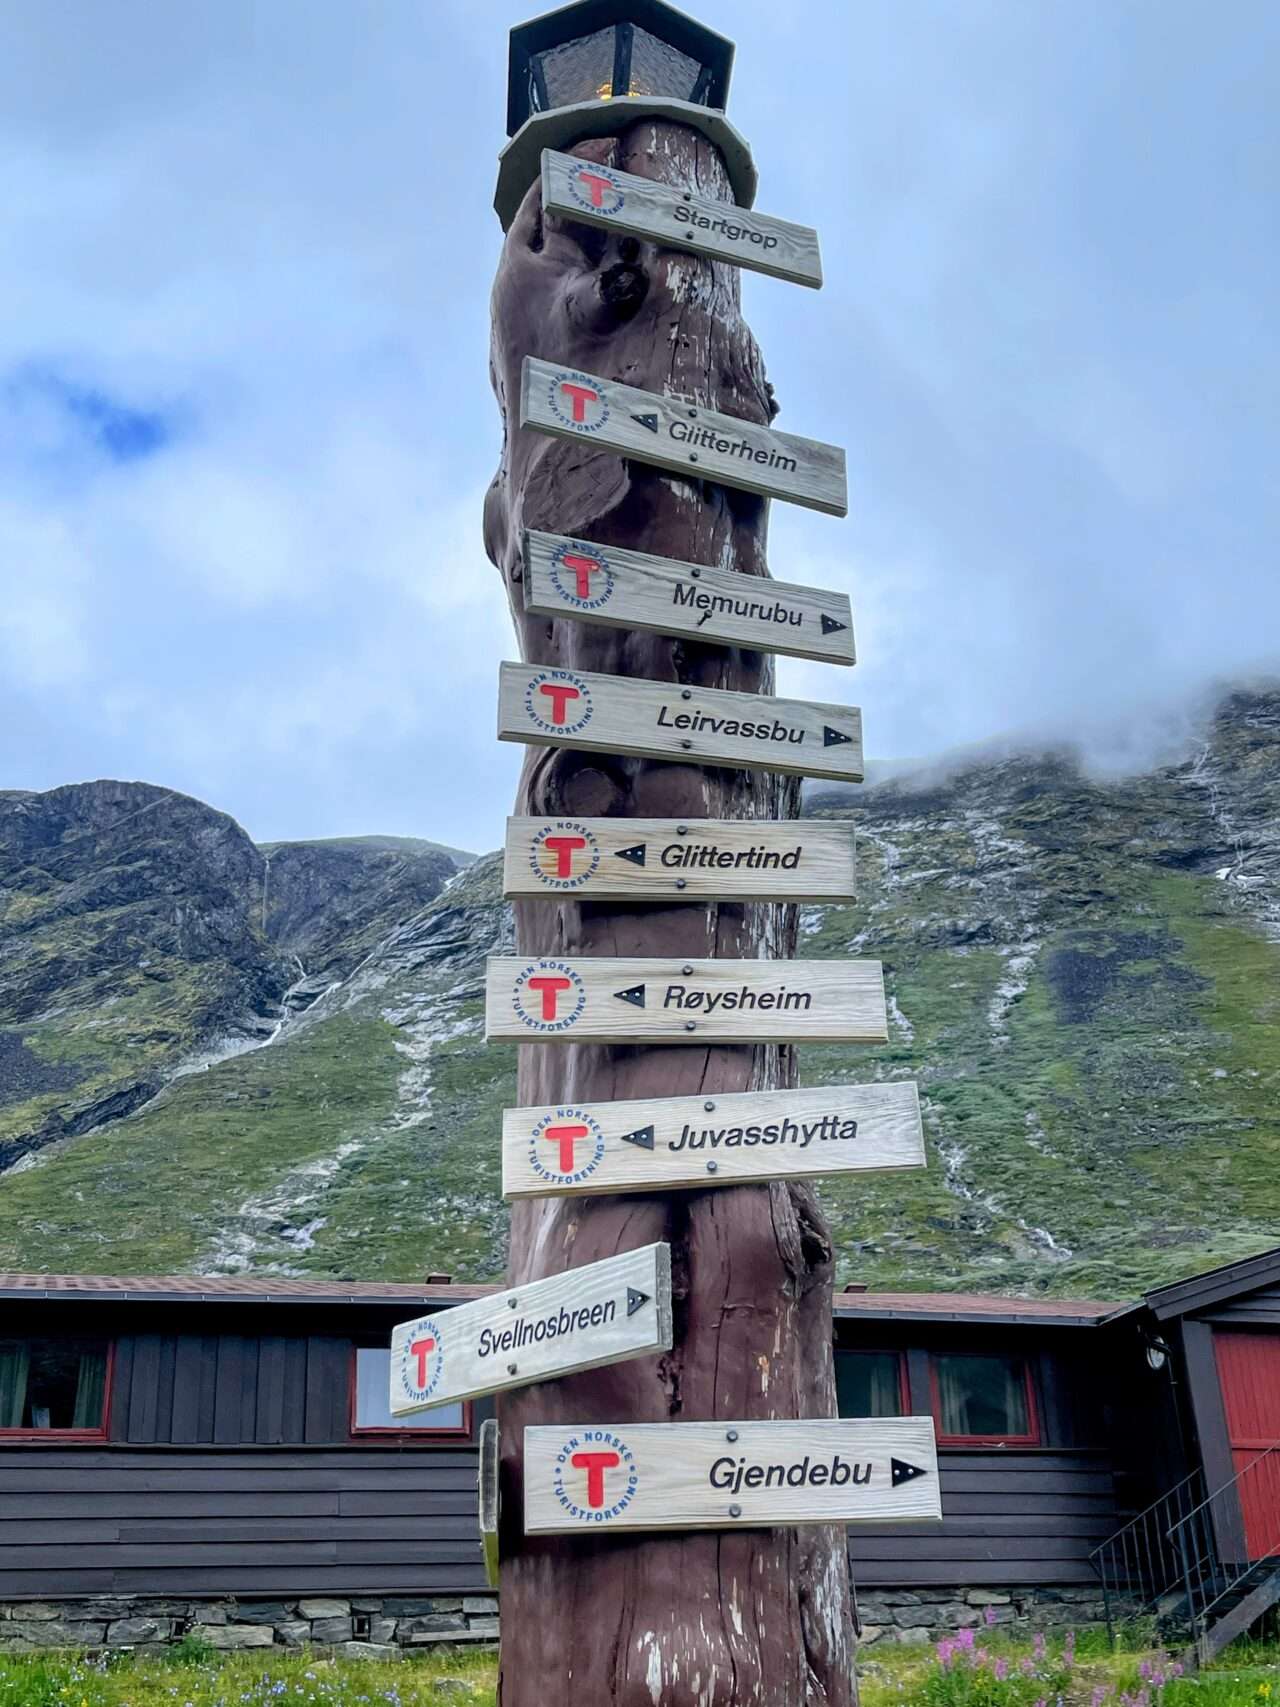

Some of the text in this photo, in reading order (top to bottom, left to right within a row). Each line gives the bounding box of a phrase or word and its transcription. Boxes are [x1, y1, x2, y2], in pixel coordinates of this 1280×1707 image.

[579, 171, 613, 208] T
[673, 205, 778, 250] Startgrop
[561, 383, 597, 422] T
[669, 421, 797, 473] Glitterheim
[562, 555, 600, 599] T
[673, 583, 803, 627] Memurubu
[528, 671, 590, 696] DEN NORSKE
[525, 700, 594, 735] TURISTFORENING
[540, 684, 579, 725] T
[657, 706, 805, 745] Leirvassbu
[532, 825, 552, 844] DEN
[529, 855, 600, 889] TURISTFORENING
[545, 837, 586, 878] T
[660, 843, 803, 870] Glittertind
[515, 961, 582, 985] DEN NORSKE
[512, 997, 586, 1031] TURISTFORENING
[528, 977, 571, 1021] T
[664, 984, 812, 1014] Røysheim
[532, 1109, 600, 1137] DEN NORSKE
[668, 1115, 858, 1152] Juvasshytta
[528, 1144, 605, 1184] TURISTFORENING
[545, 1125, 589, 1173] T
[478, 1299, 616, 1358] Svellnosbreen
[411, 1338, 435, 1389] T
[557, 1431, 633, 1463] DEN NORSKE
[571, 1452, 620, 1508] T
[708, 1455, 873, 1494] Gjendebu
[553, 1476, 638, 1522] TURISTFORENING
